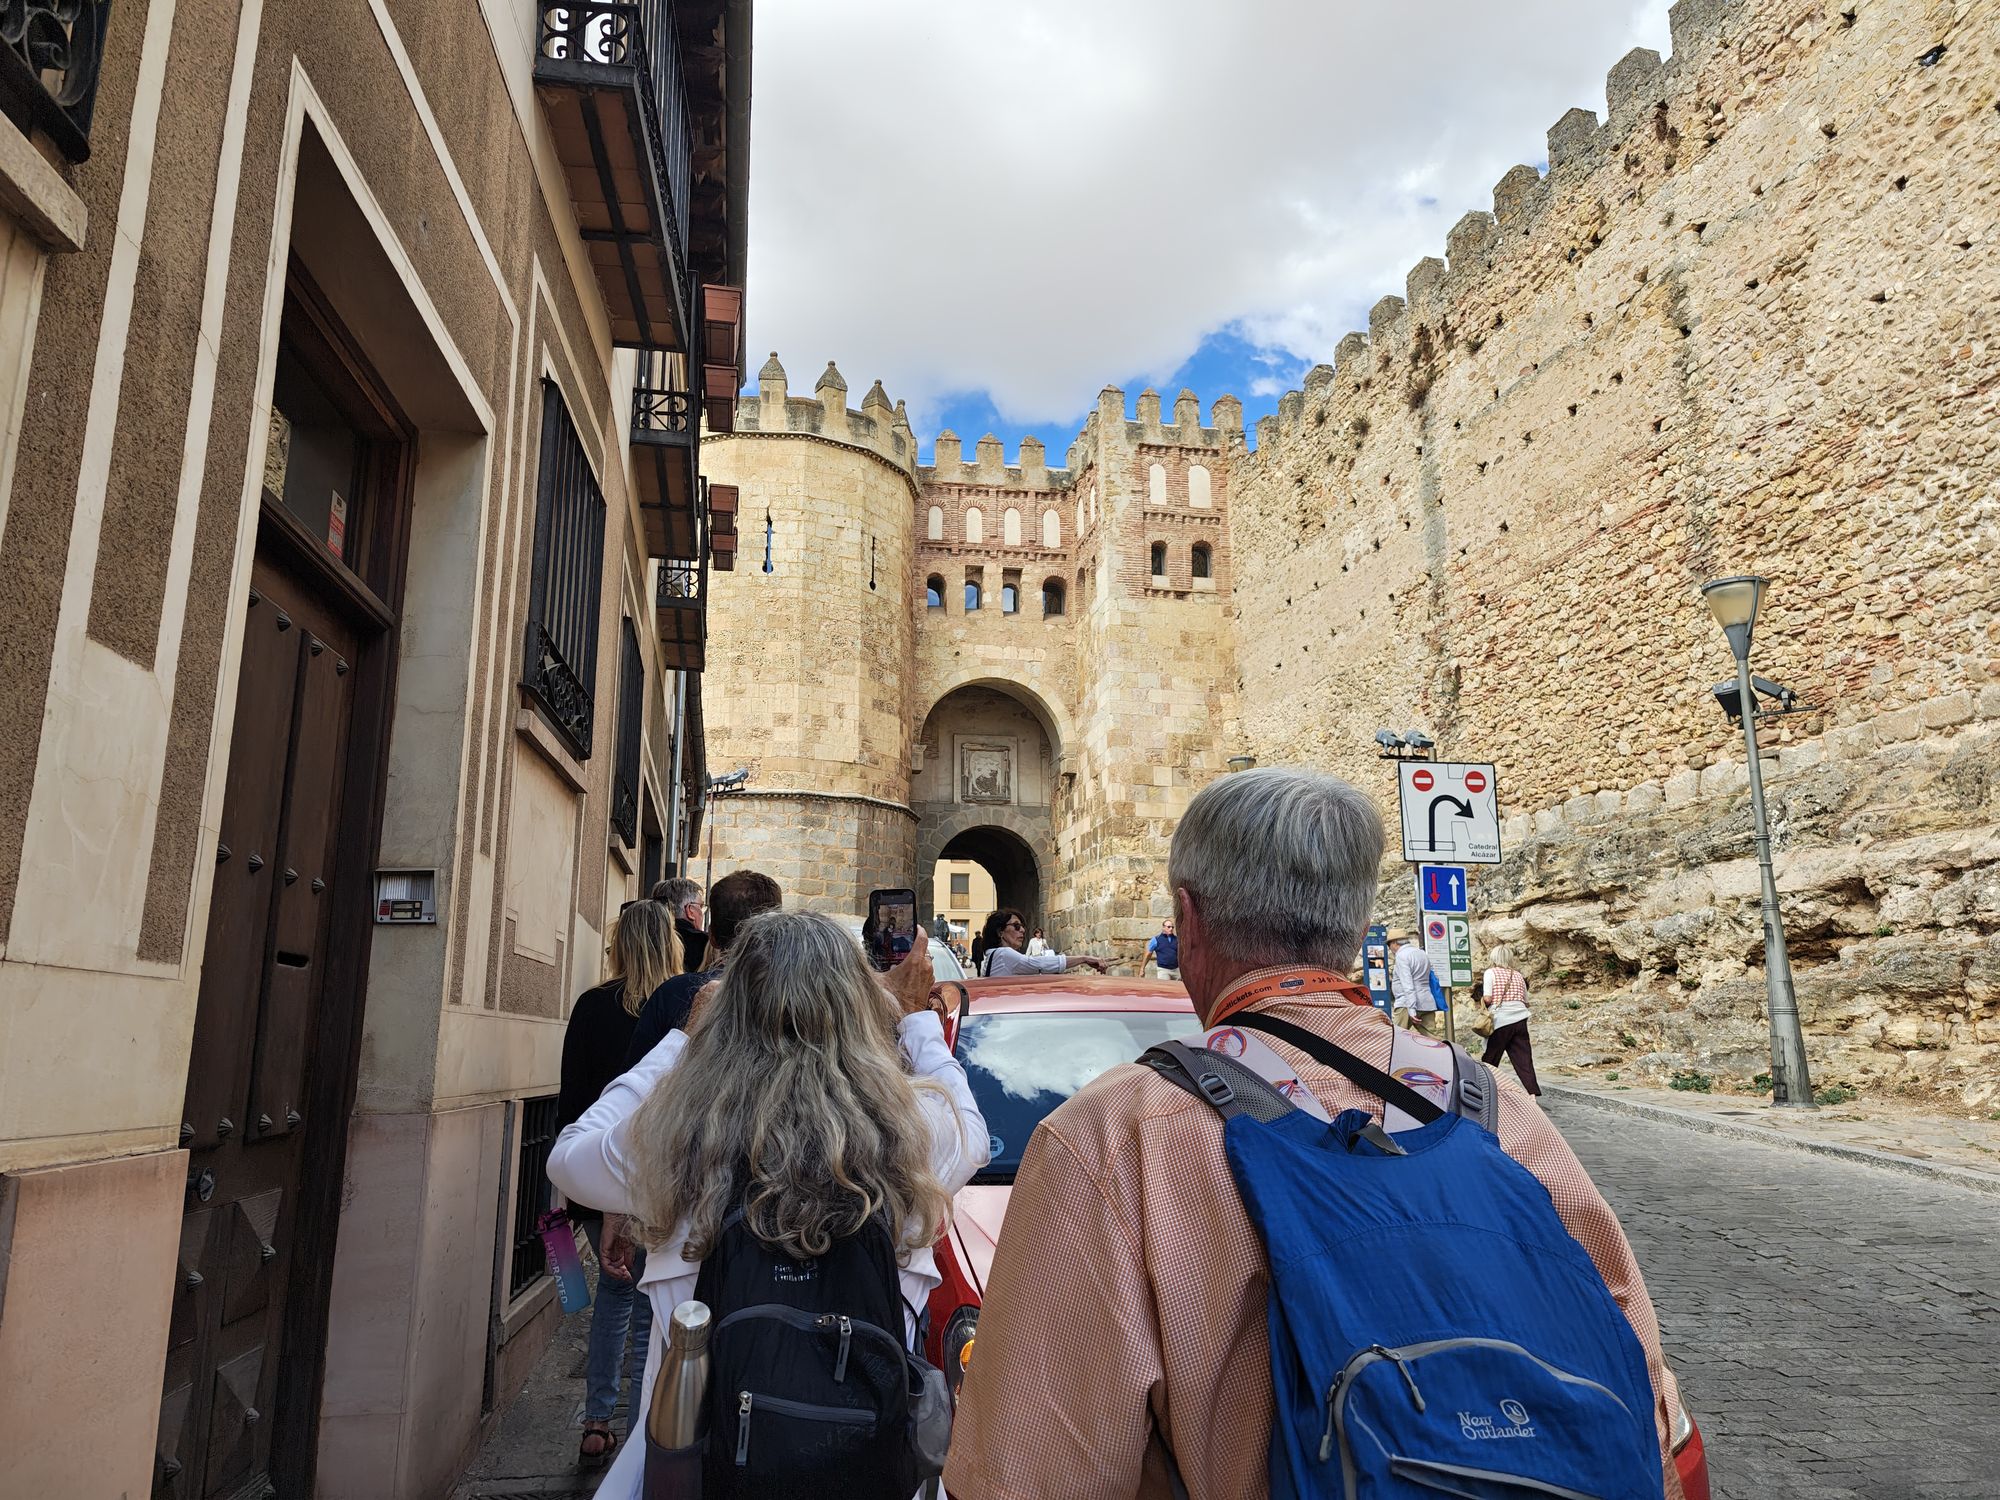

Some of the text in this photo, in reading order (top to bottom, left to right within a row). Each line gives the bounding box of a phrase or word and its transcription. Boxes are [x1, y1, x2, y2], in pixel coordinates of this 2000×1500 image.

[1468, 842, 1498, 850] Catedral
[1449, 920, 1469, 952] P
[545, 1241, 568, 1304] HYDRATED
[1457, 1411, 1492, 1426] New
[1462, 1424, 1535, 1440] Outlander
